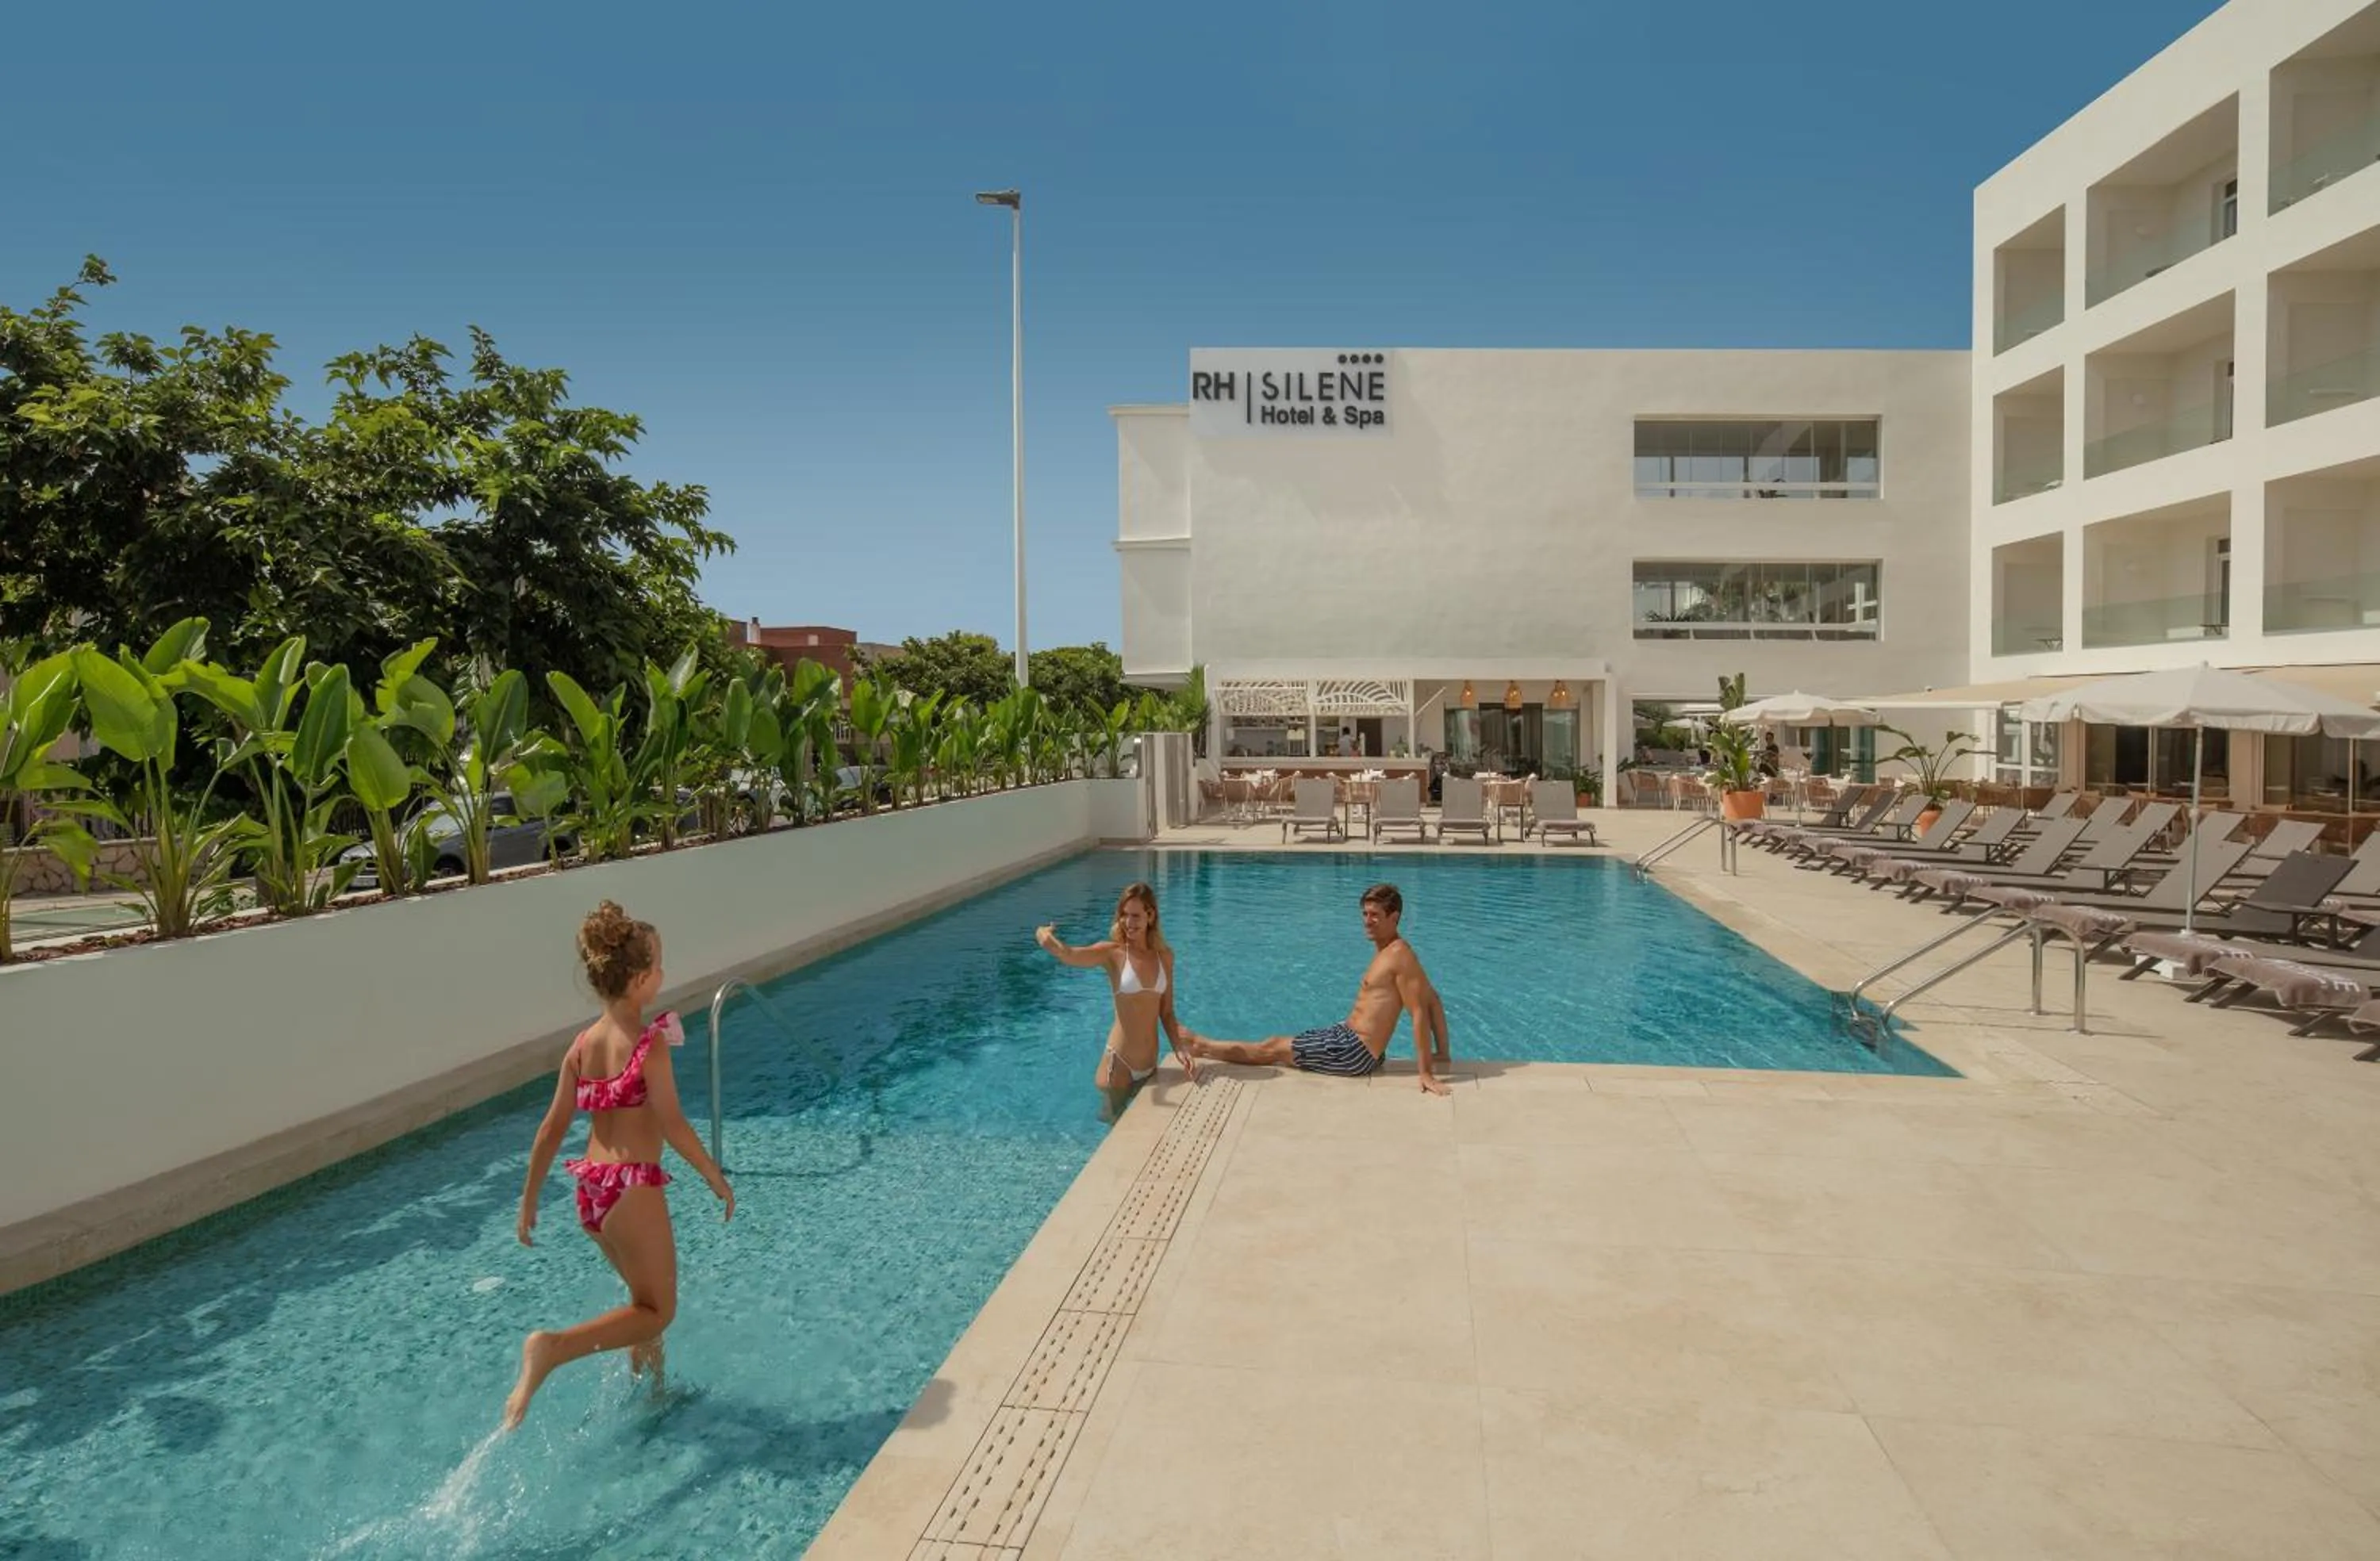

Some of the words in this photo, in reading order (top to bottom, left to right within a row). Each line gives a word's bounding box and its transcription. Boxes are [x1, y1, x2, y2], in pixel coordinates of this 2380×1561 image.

[1192, 371, 1235, 400] RH
[1261, 371, 1384, 401] SILENE
[1261, 405, 1315, 424] Hotel
[1322, 406, 1337, 424] &
[1344, 405, 1384, 428] Spa
